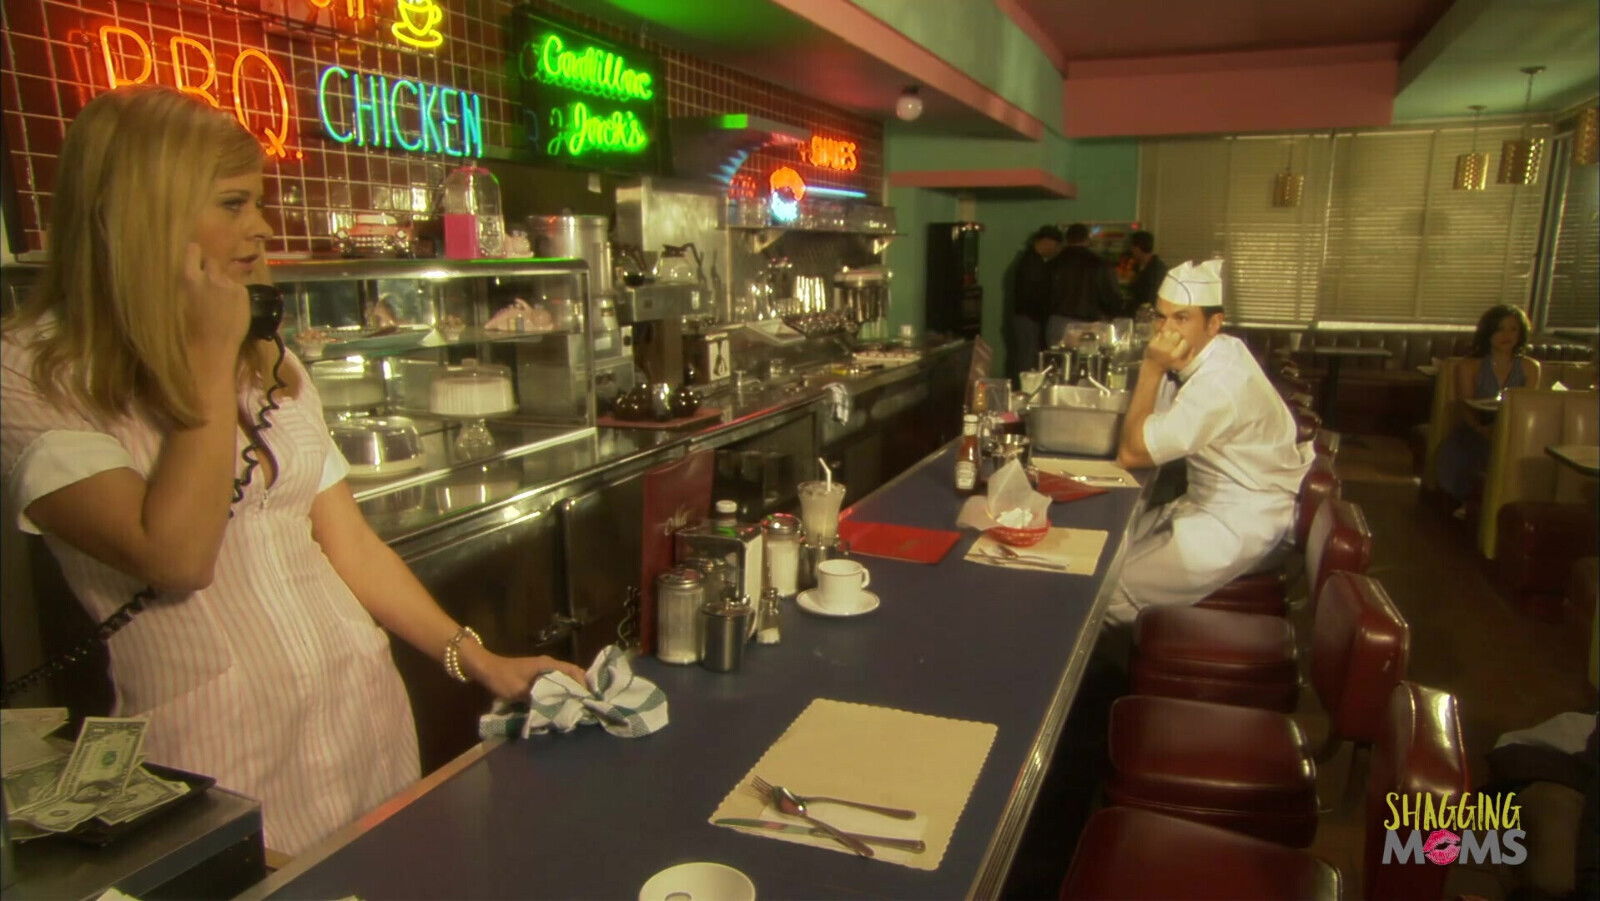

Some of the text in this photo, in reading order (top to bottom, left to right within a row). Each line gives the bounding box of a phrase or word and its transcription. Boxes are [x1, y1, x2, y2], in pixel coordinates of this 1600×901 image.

[543, 34, 653, 100] Cadillac
[319, 66, 483, 158] CHICKEN
[568, 102, 649, 156] Jack's
